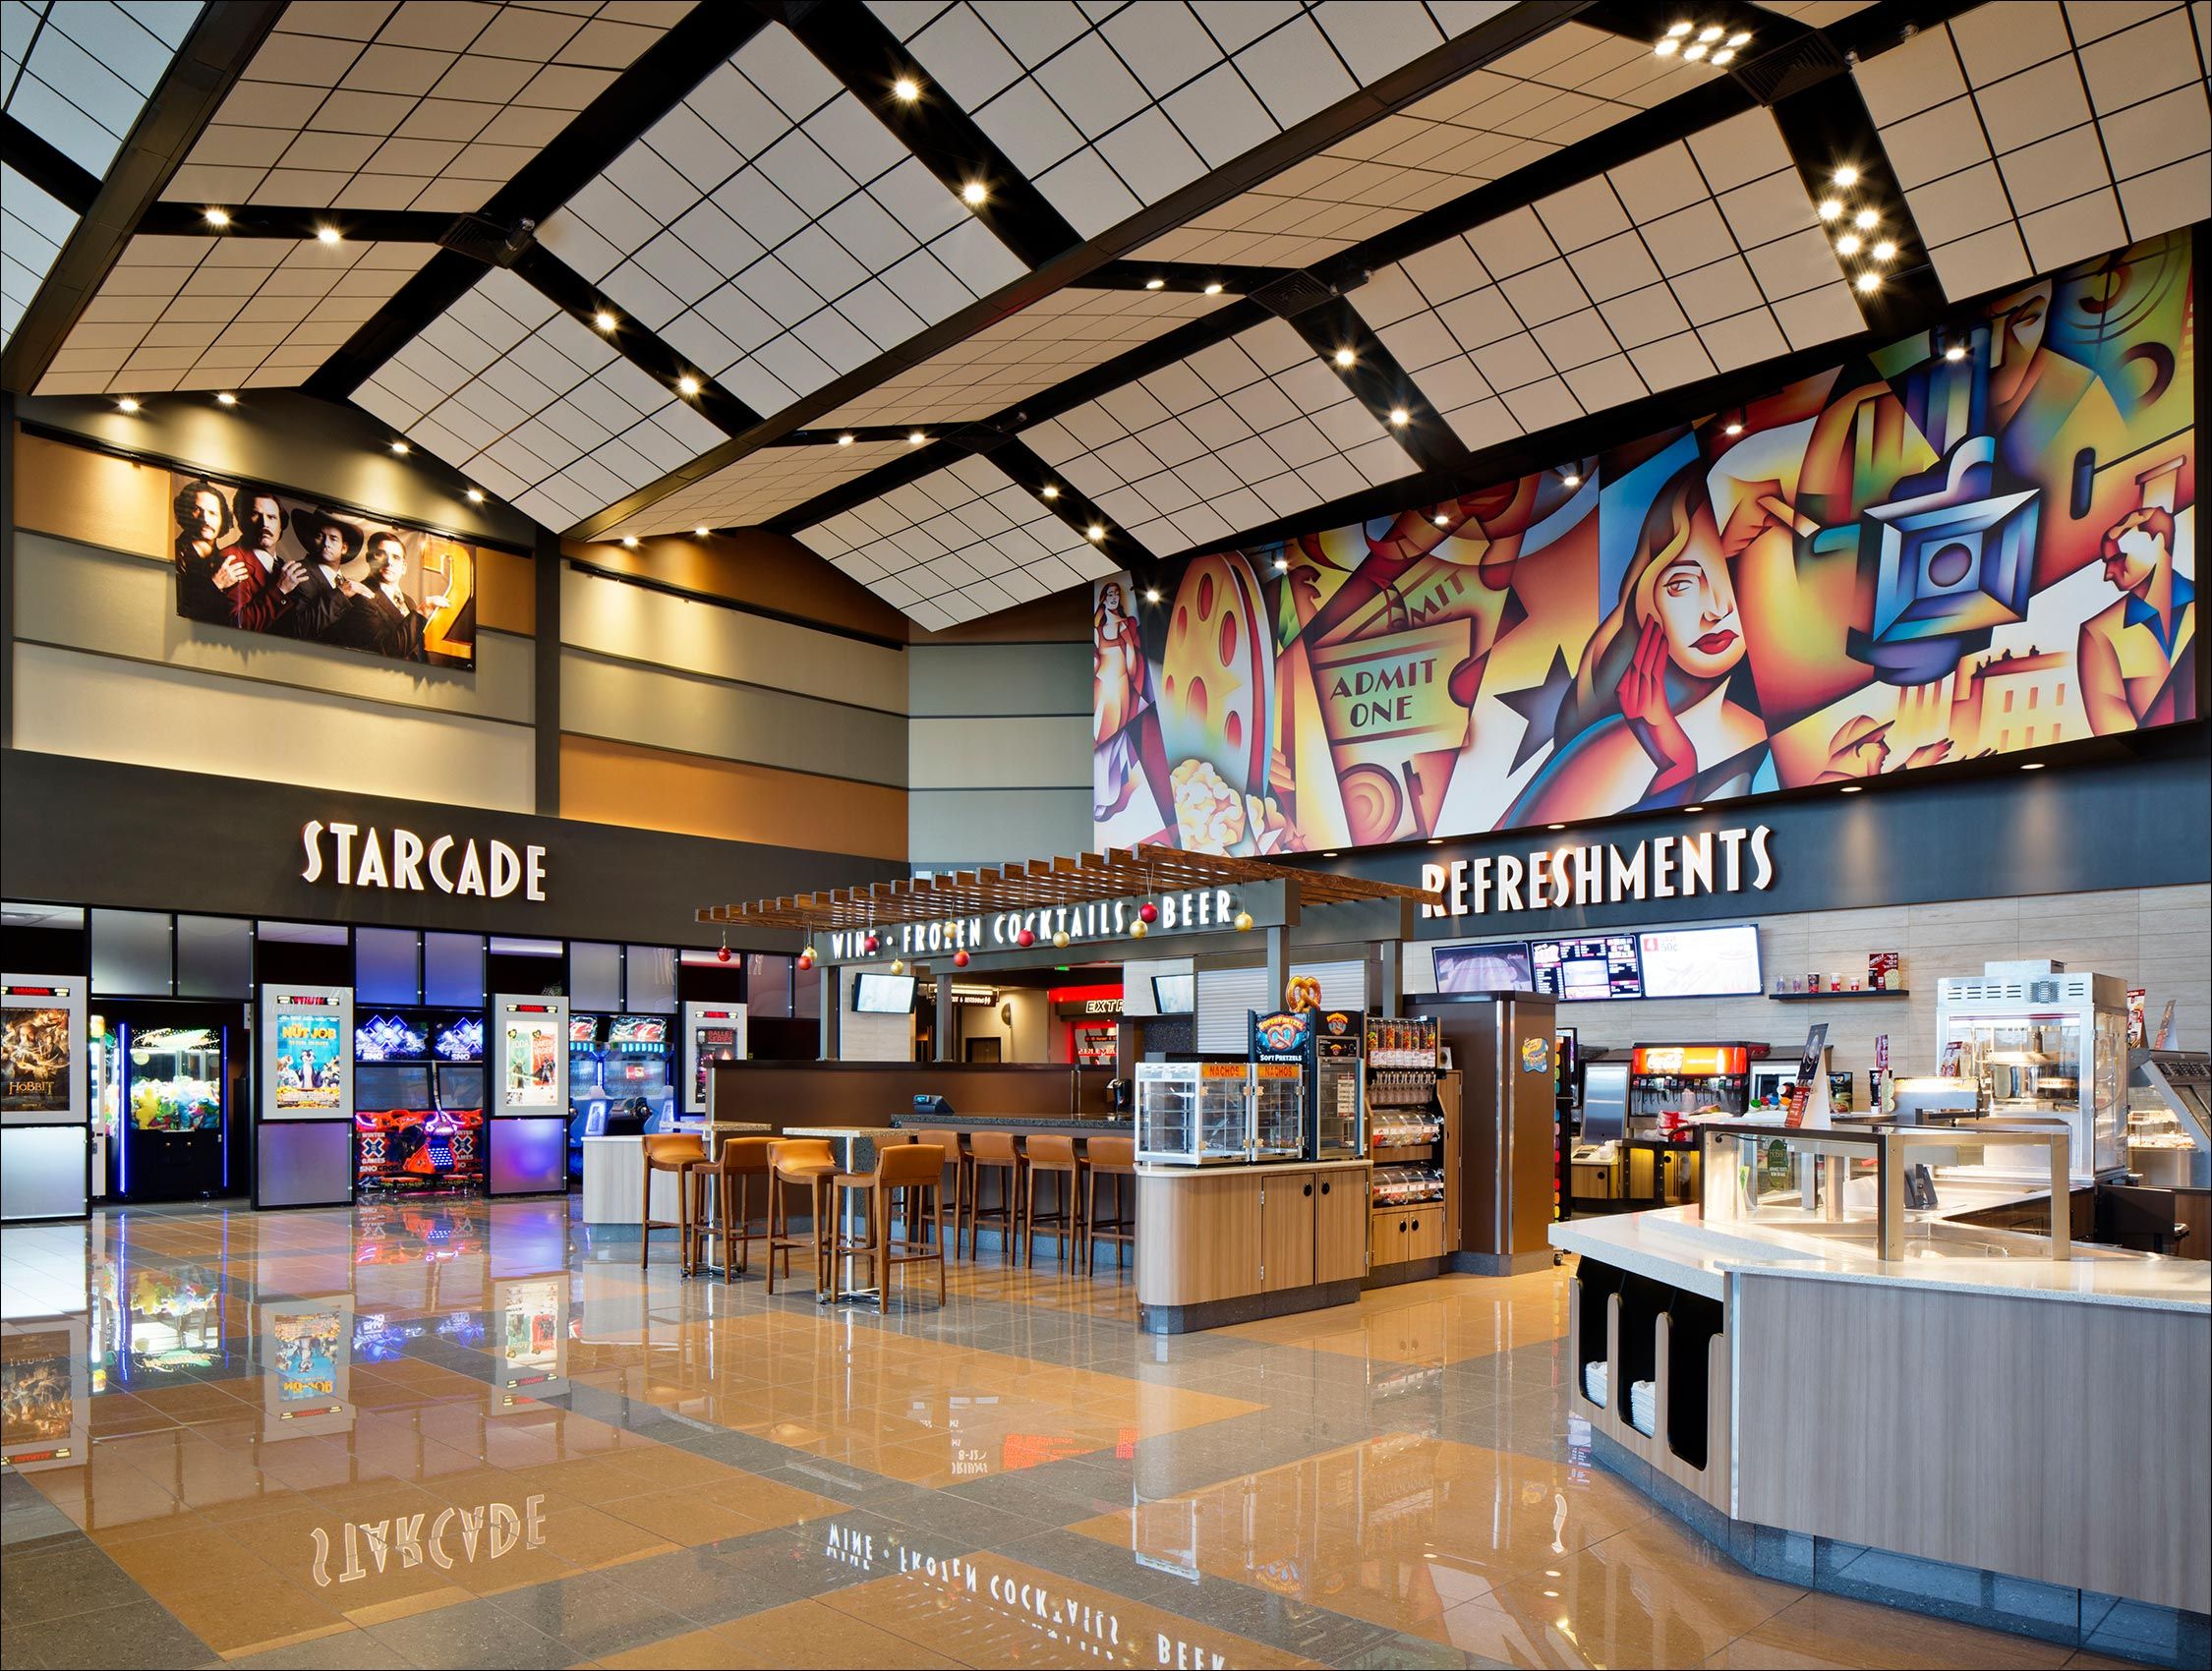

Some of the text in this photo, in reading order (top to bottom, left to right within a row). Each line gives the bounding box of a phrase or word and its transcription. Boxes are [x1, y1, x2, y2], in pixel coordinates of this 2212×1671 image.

[1409, 568, 1465, 626] MIT
[1330, 658, 1437, 700] ADMIT
[1349, 695, 1413, 727] ONE
[301, 820, 546, 901] STARCADE
[1422, 825, 1773, 918] REFRESHMENTS
[994, 900, 1125, 944] COCKTAILS
[1163, 890, 1231, 929] BEER
[310, 1027, 337, 1039] JOB
[9, 1081, 54, 1095] HOBBIT
[1209, 1066, 1240, 1076] NACHOS
[1264, 1066, 1293, 1076] NACHOS
